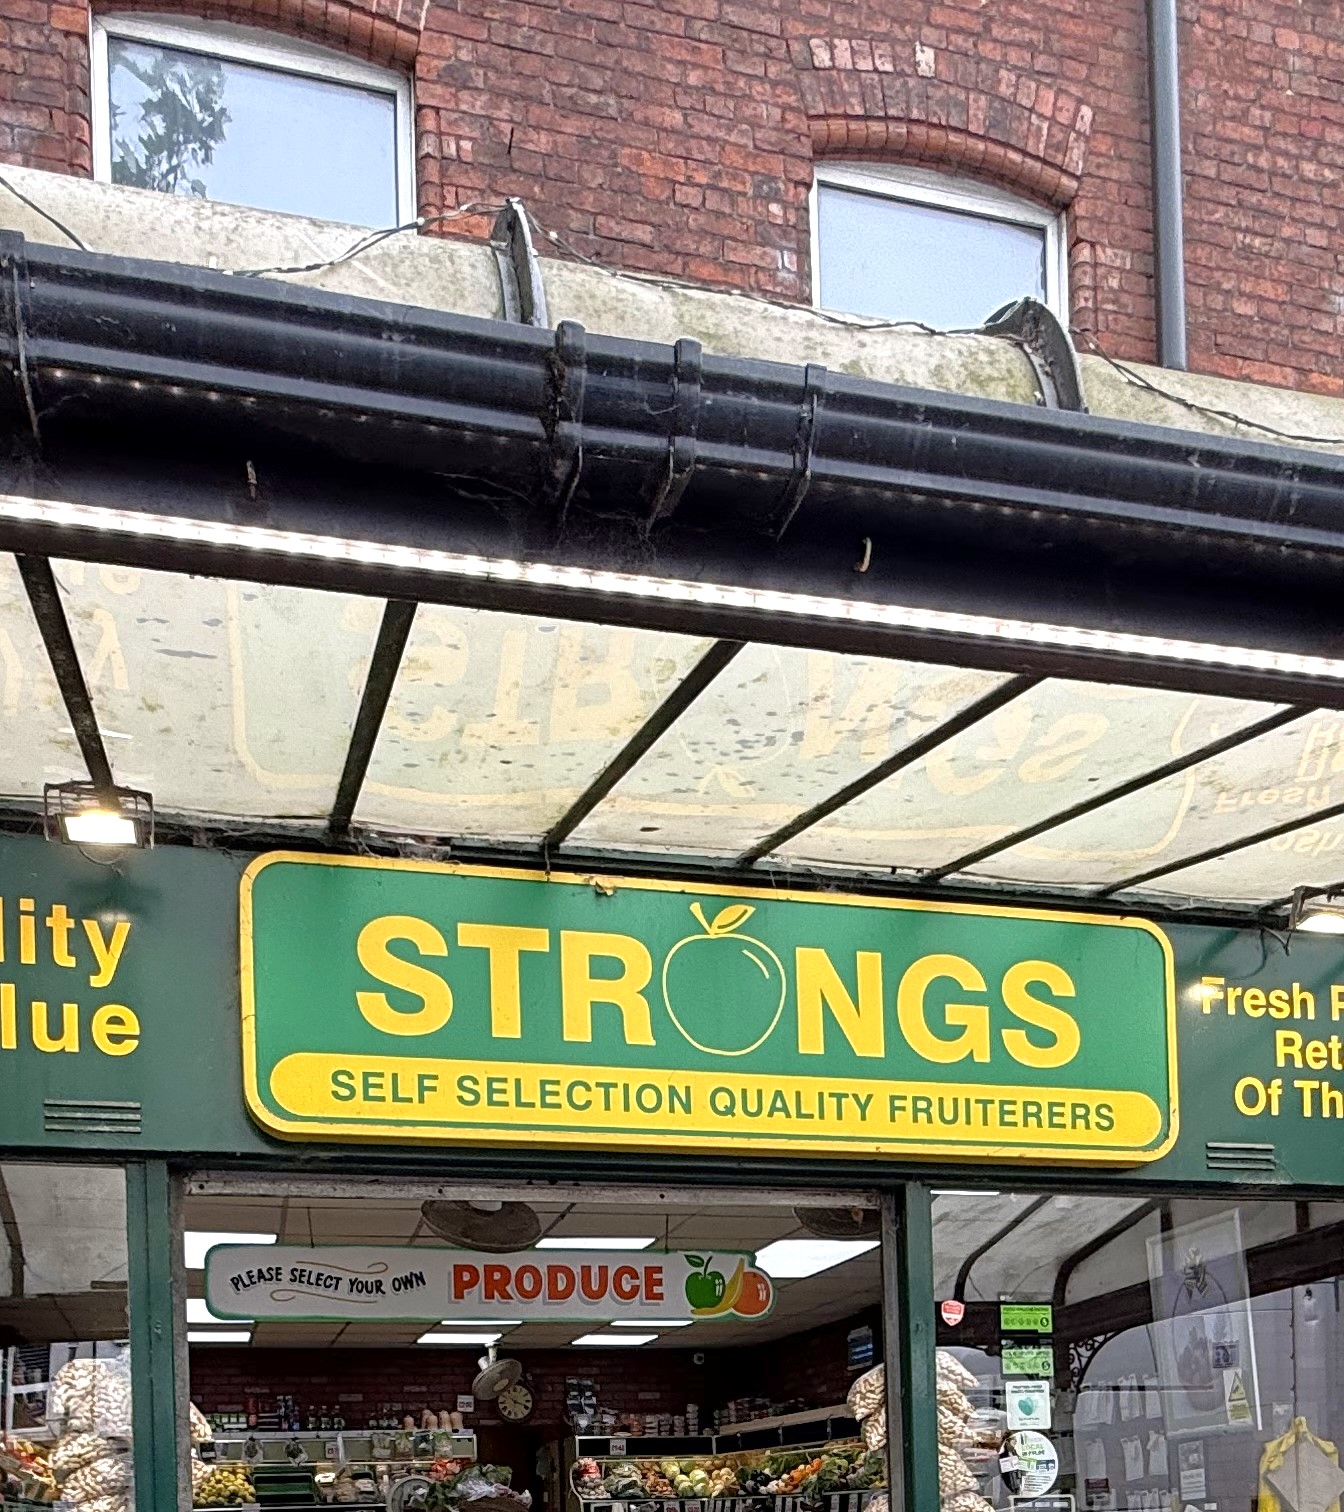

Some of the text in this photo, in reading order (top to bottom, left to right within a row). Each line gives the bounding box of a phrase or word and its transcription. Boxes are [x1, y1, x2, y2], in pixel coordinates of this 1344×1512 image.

[1201, 976, 1316, 1020] Fresh
[330, 1069, 1115, 1133] SELF SELECTION QUALITY FRUITERERS
[1234, 1076, 1283, 1116] Of
[230, 1266, 427, 1295] PLEASE SELECT YOUR OWN
[453, 1263, 665, 1303] PRODUCE
